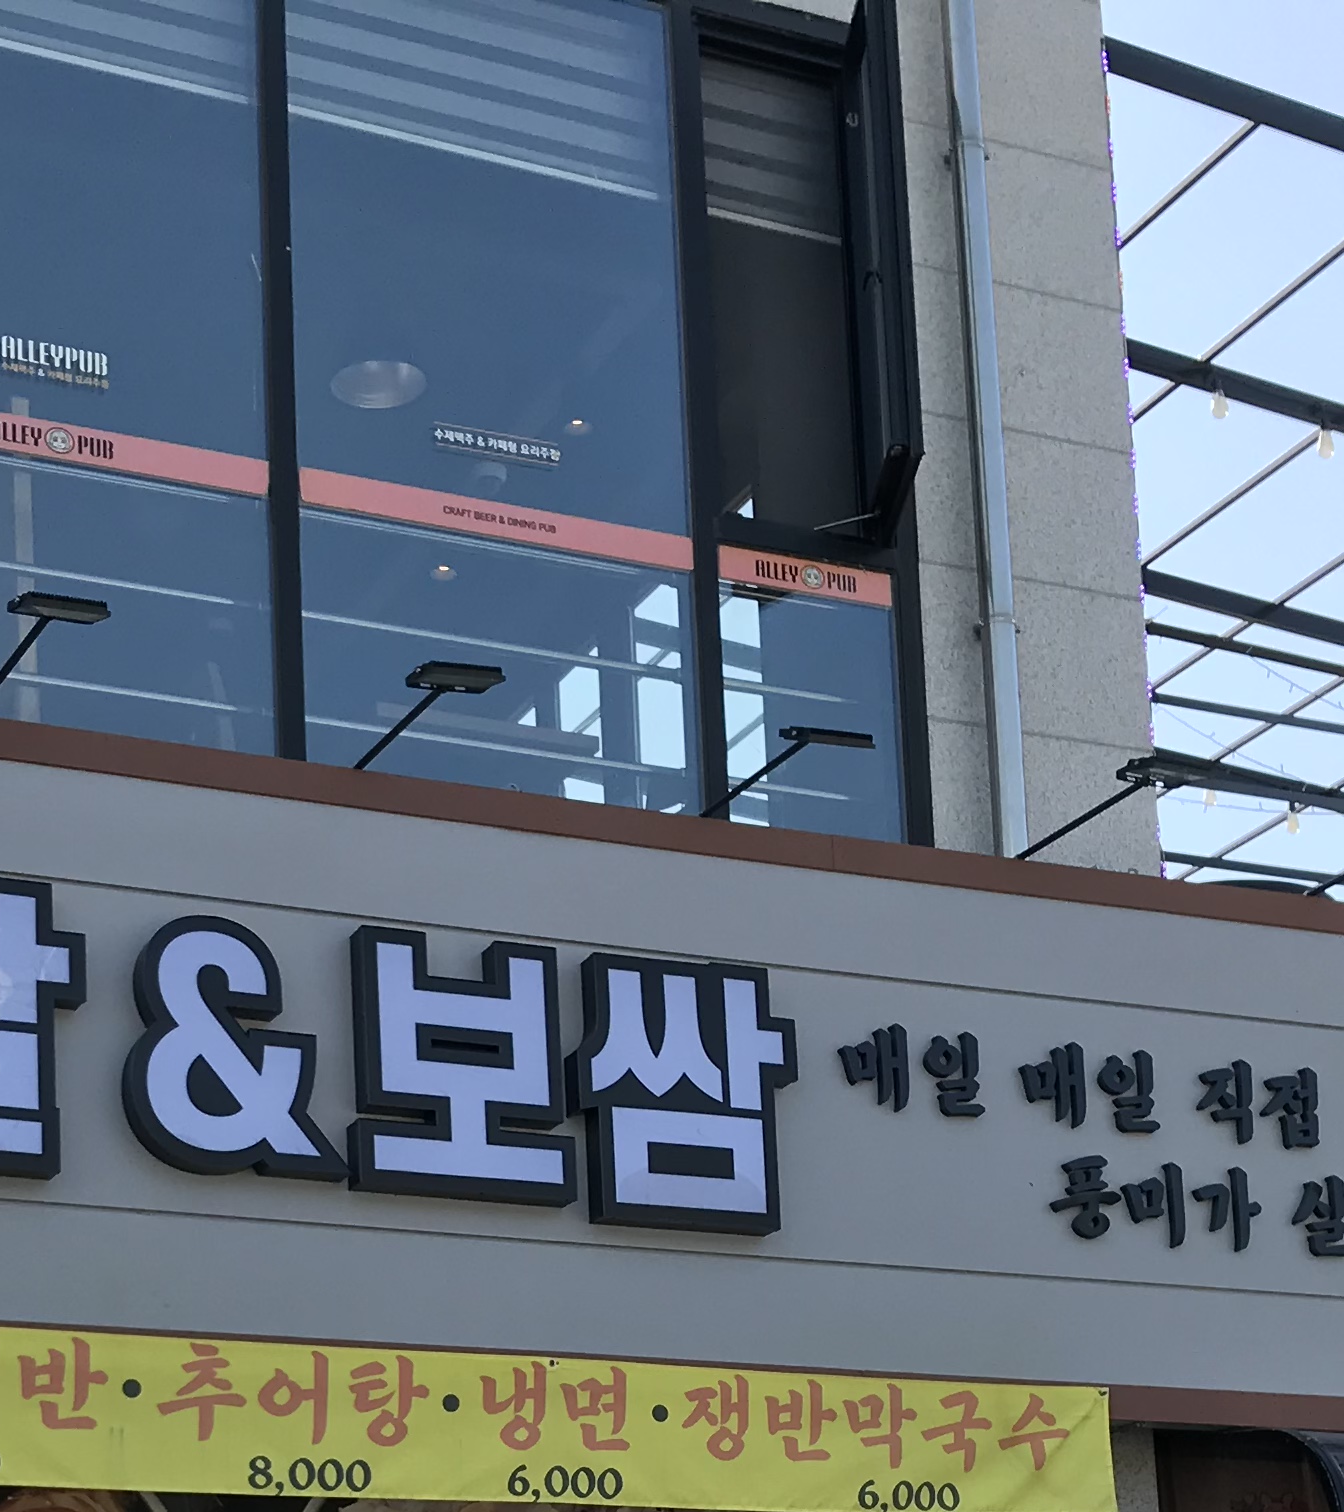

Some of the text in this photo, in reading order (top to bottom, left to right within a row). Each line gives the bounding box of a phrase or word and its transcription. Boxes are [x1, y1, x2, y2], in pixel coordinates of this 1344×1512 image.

[1, 335, 108, 376] ALLEYPUB
[77, 435, 114, 460] PUB
[443, 505, 471, 518] CRAFT
[474, 510, 496, 523] BEER
[539, 523, 556, 534] PUB
[755, 559, 857, 593] ALLEY PUB
[123, 915, 350, 1183] &
[348, 925, 797, 1236] 보쌈
[837, 1022, 986, 1118] 매일
[1019, 1040, 1160, 1135] 매일
[1196, 1058, 1320, 1150] 직접
[1048, 1154, 1262, 1253] 풍미가
[156, 1343, 429, 1448] 추어탕
[478, 1361, 632, 1453] 냉면
[247, 1455, 373, 1496] 8,000
[506, 1464, 625, 1505] 6,000
